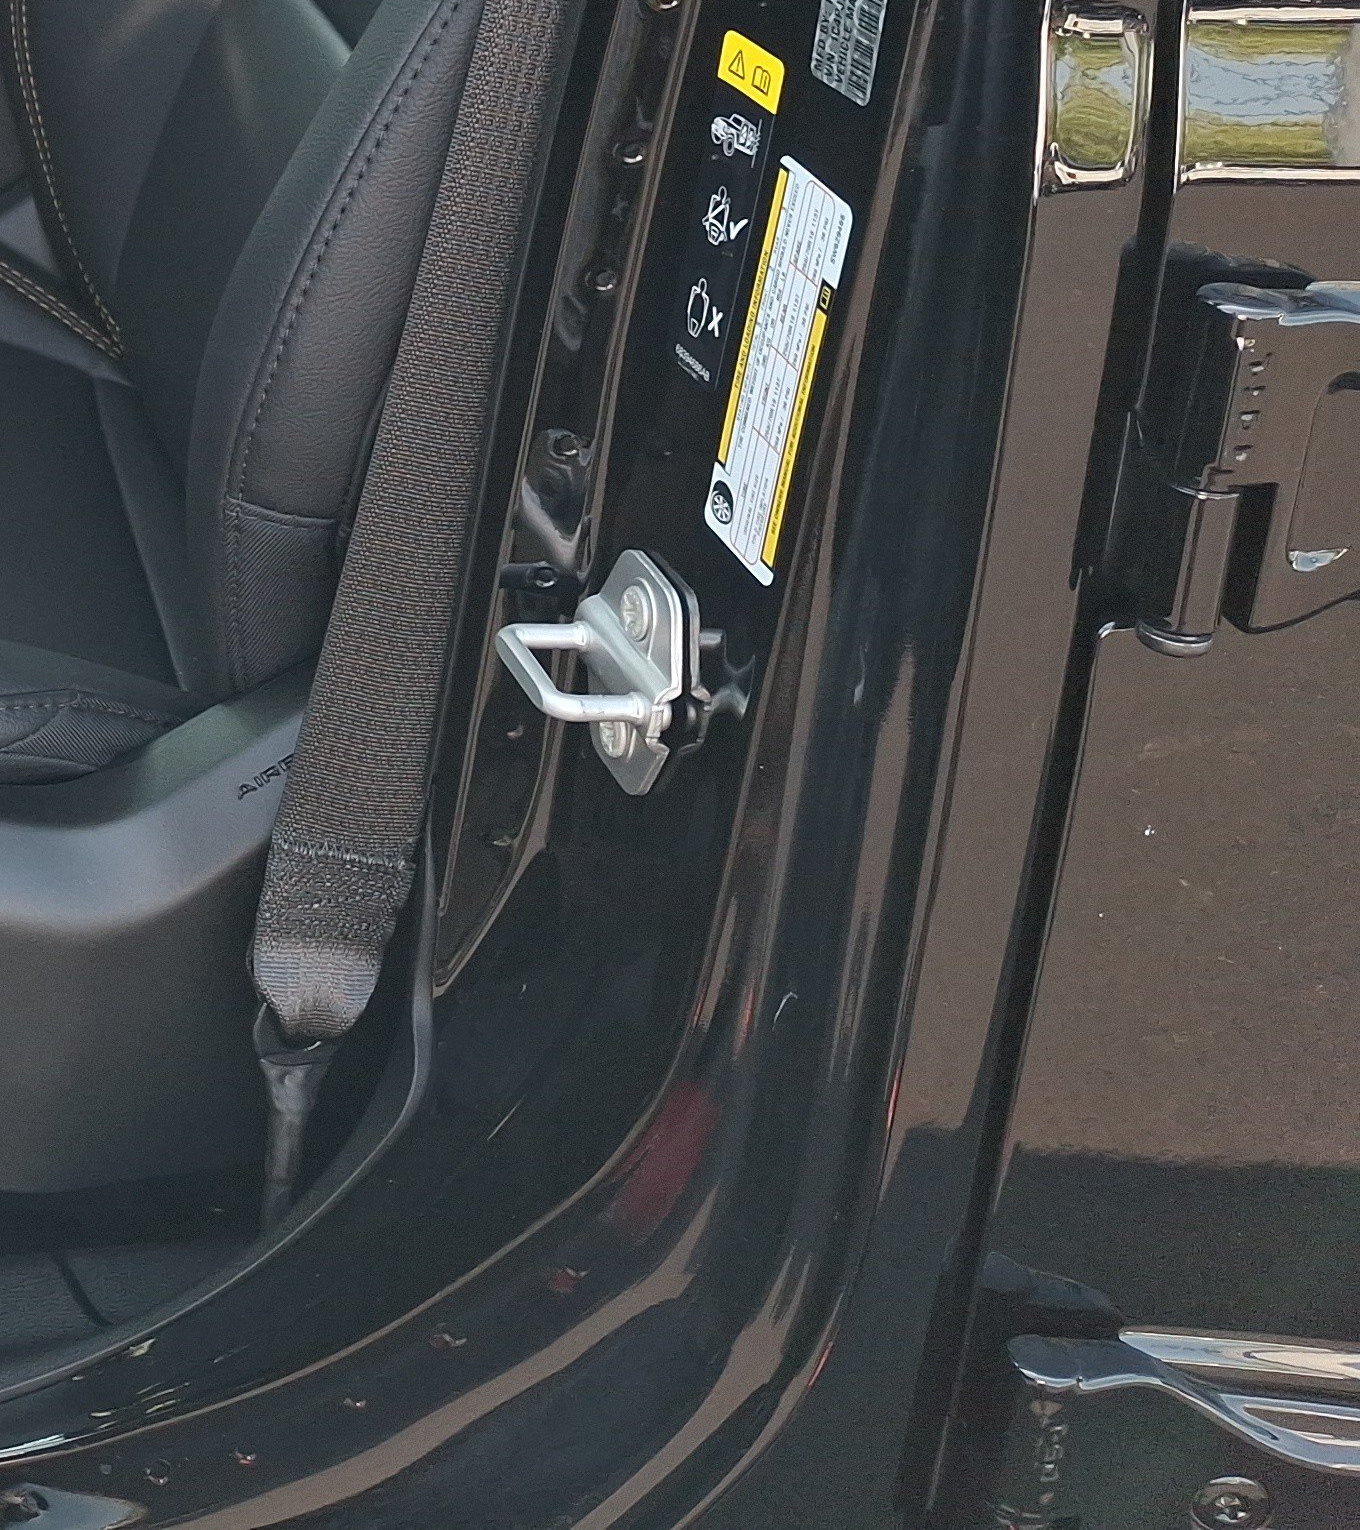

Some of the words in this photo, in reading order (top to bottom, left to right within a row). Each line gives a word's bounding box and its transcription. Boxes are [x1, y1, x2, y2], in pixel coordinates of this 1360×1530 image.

[834, 25, 852, 80] VEHICLE
[743, 309, 754, 349] LOADING
[751, 248, 768, 310] INFORMATION
